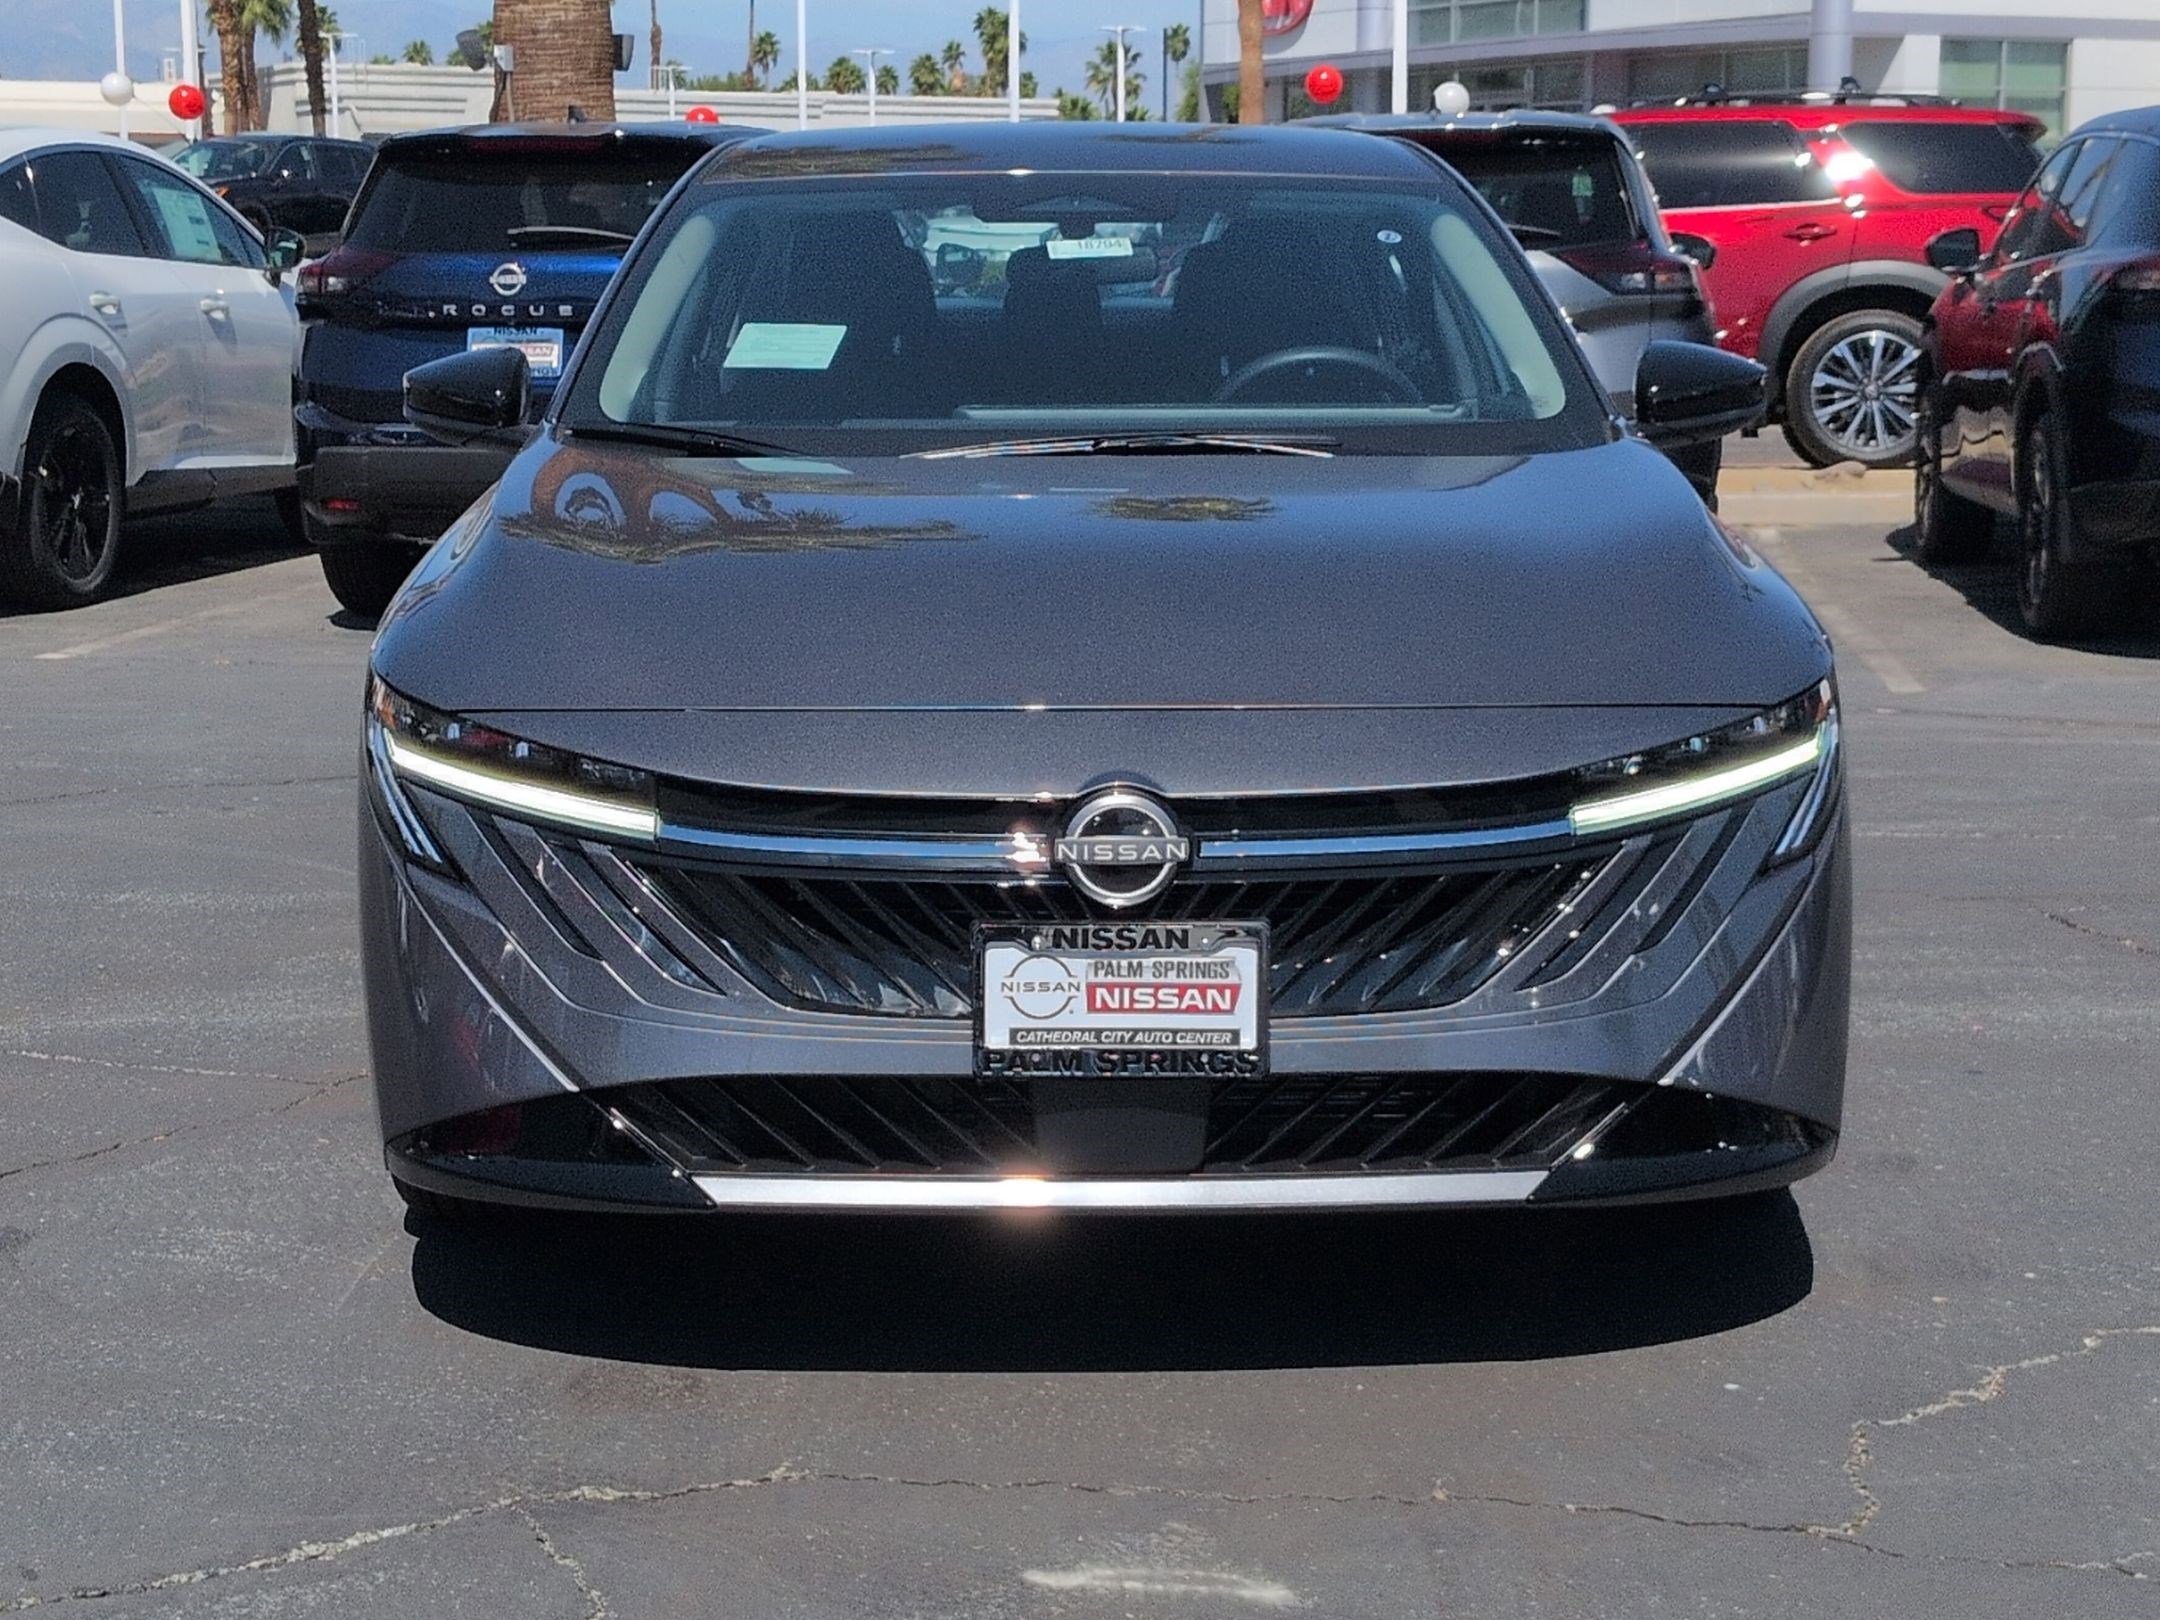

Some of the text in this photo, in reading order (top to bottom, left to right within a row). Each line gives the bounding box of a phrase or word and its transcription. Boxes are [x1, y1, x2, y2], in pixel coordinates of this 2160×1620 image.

[443, 304, 573, 316] ROGUE
[1057, 843, 1186, 860] NISSAN
[1052, 927, 1189, 950] NISSAN
[1093, 960, 1230, 980] PALM SPRINGS
[1001, 981, 1081, 993] NISSAN
[1095, 987, 1231, 1010] NISSAN
[1016, 1031, 1232, 1044] CATHEDRAL CITY AUTO CENTER
[983, 1049, 1260, 1076] PALM SPRINGS
